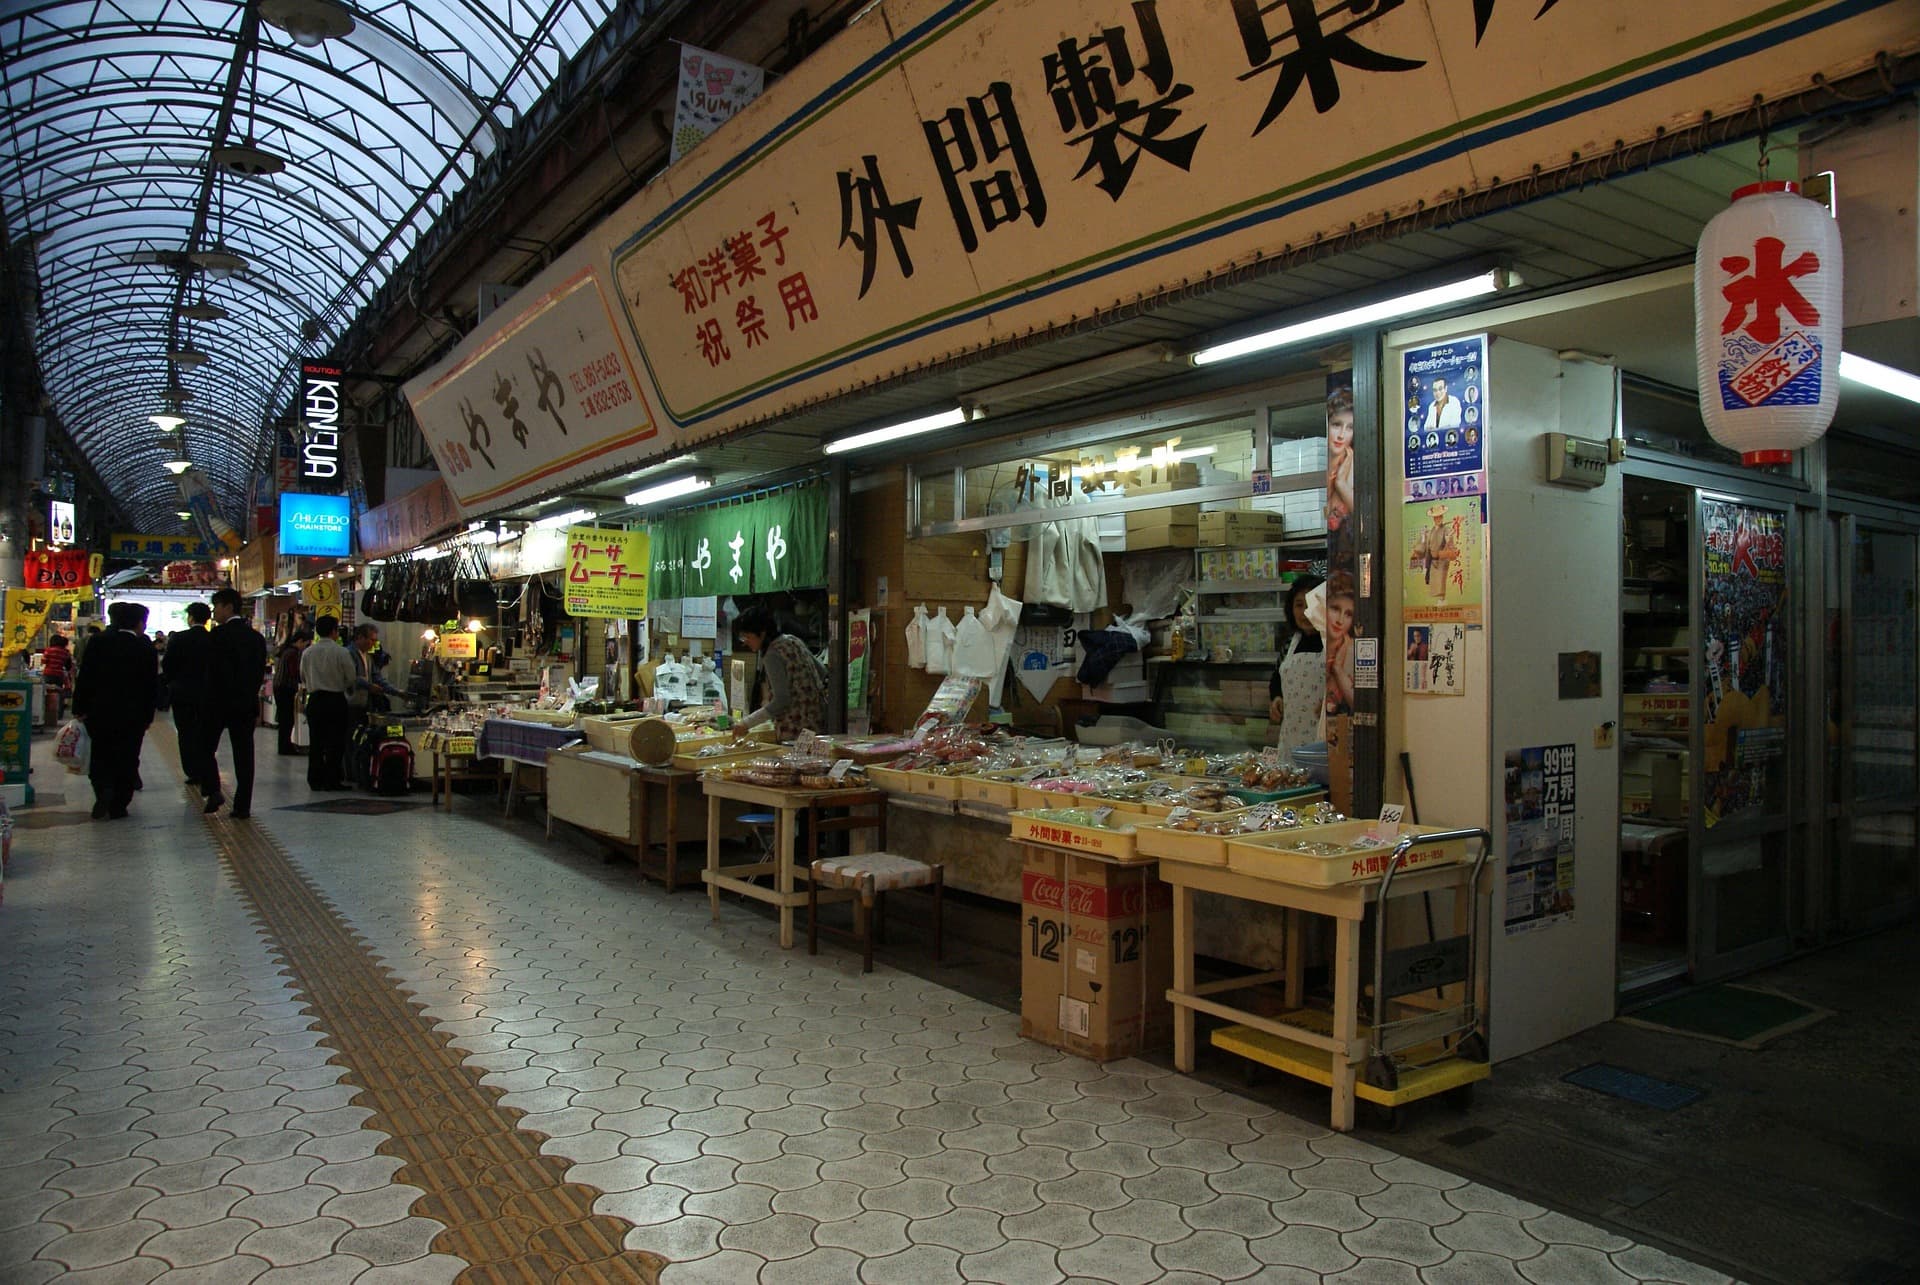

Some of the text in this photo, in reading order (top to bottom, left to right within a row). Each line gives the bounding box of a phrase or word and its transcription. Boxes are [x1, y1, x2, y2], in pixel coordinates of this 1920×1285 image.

[838, 0, 1560, 301] 外間製菓
[675, 210, 791, 317] 和洋菓子
[1719, 237, 1820, 344] 氷
[696, 272, 820, 369] 祝祭用
[303, 365, 342, 376] BOUTIQUE
[287, 512, 350, 526] SHISEIDO
[294, 523, 343, 532] CHAINSTORE
[569, 561, 645, 586] ムーチー
[571, 541, 622, 562] カーサ
[691, 524, 787, 588] やまや
[1543, 748, 1560, 830] 99万円
[1559, 746, 1575, 844] 世界一周
[1030, 824, 1072, 845] 外間製菓
